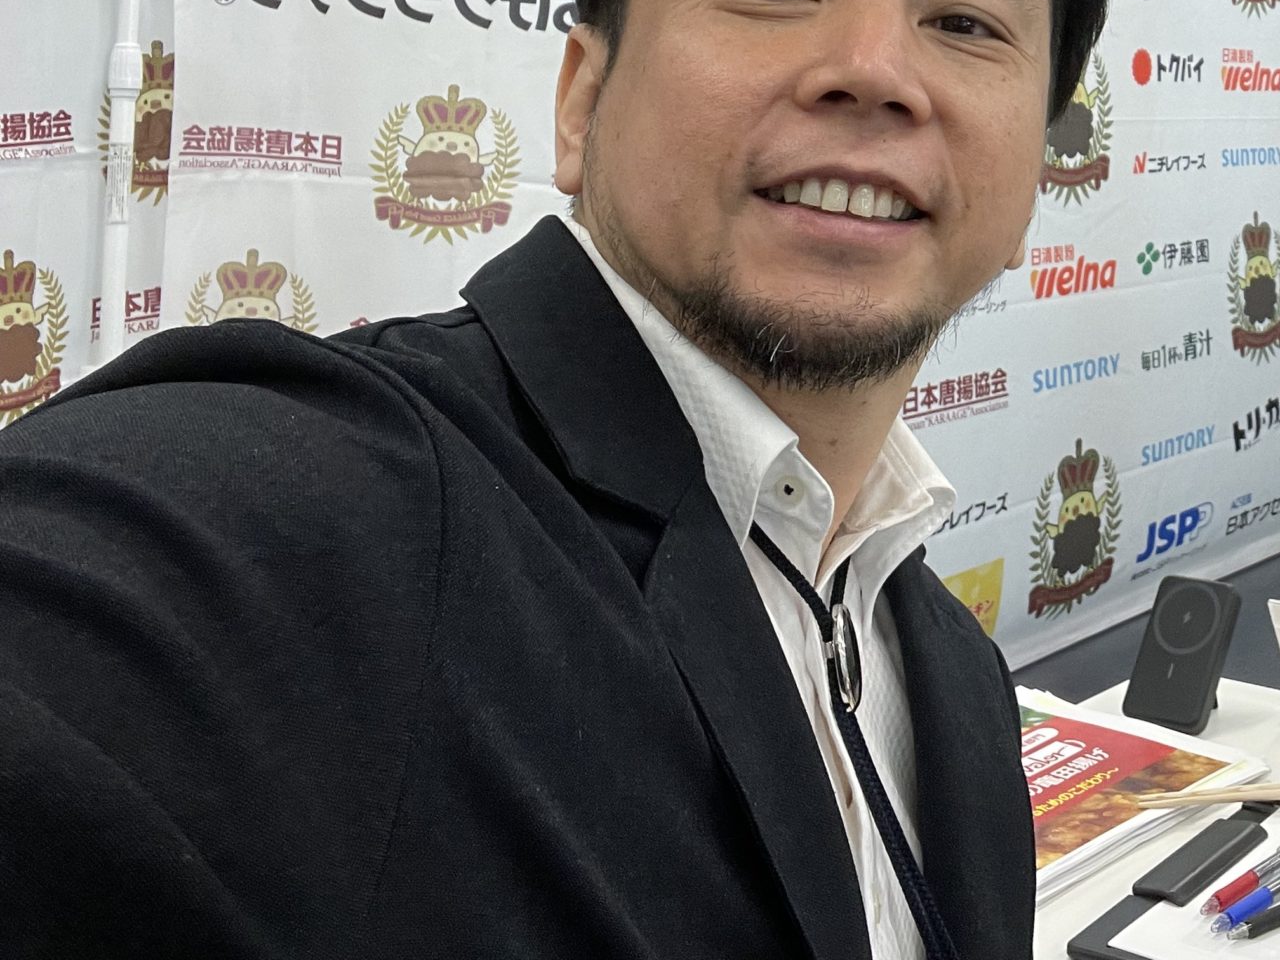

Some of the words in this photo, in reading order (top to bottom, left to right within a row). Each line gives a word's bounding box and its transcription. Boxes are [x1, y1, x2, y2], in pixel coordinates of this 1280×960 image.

[1156, 53, 1205, 83] トクバイ
[1161, 239, 1210, 269] 伊藤園
[902, 367, 1008, 416] 日本唐揚協会
[1032, 353, 1120, 394] SUNTORY
[1141, 424, 1216, 467] SUNTORY
